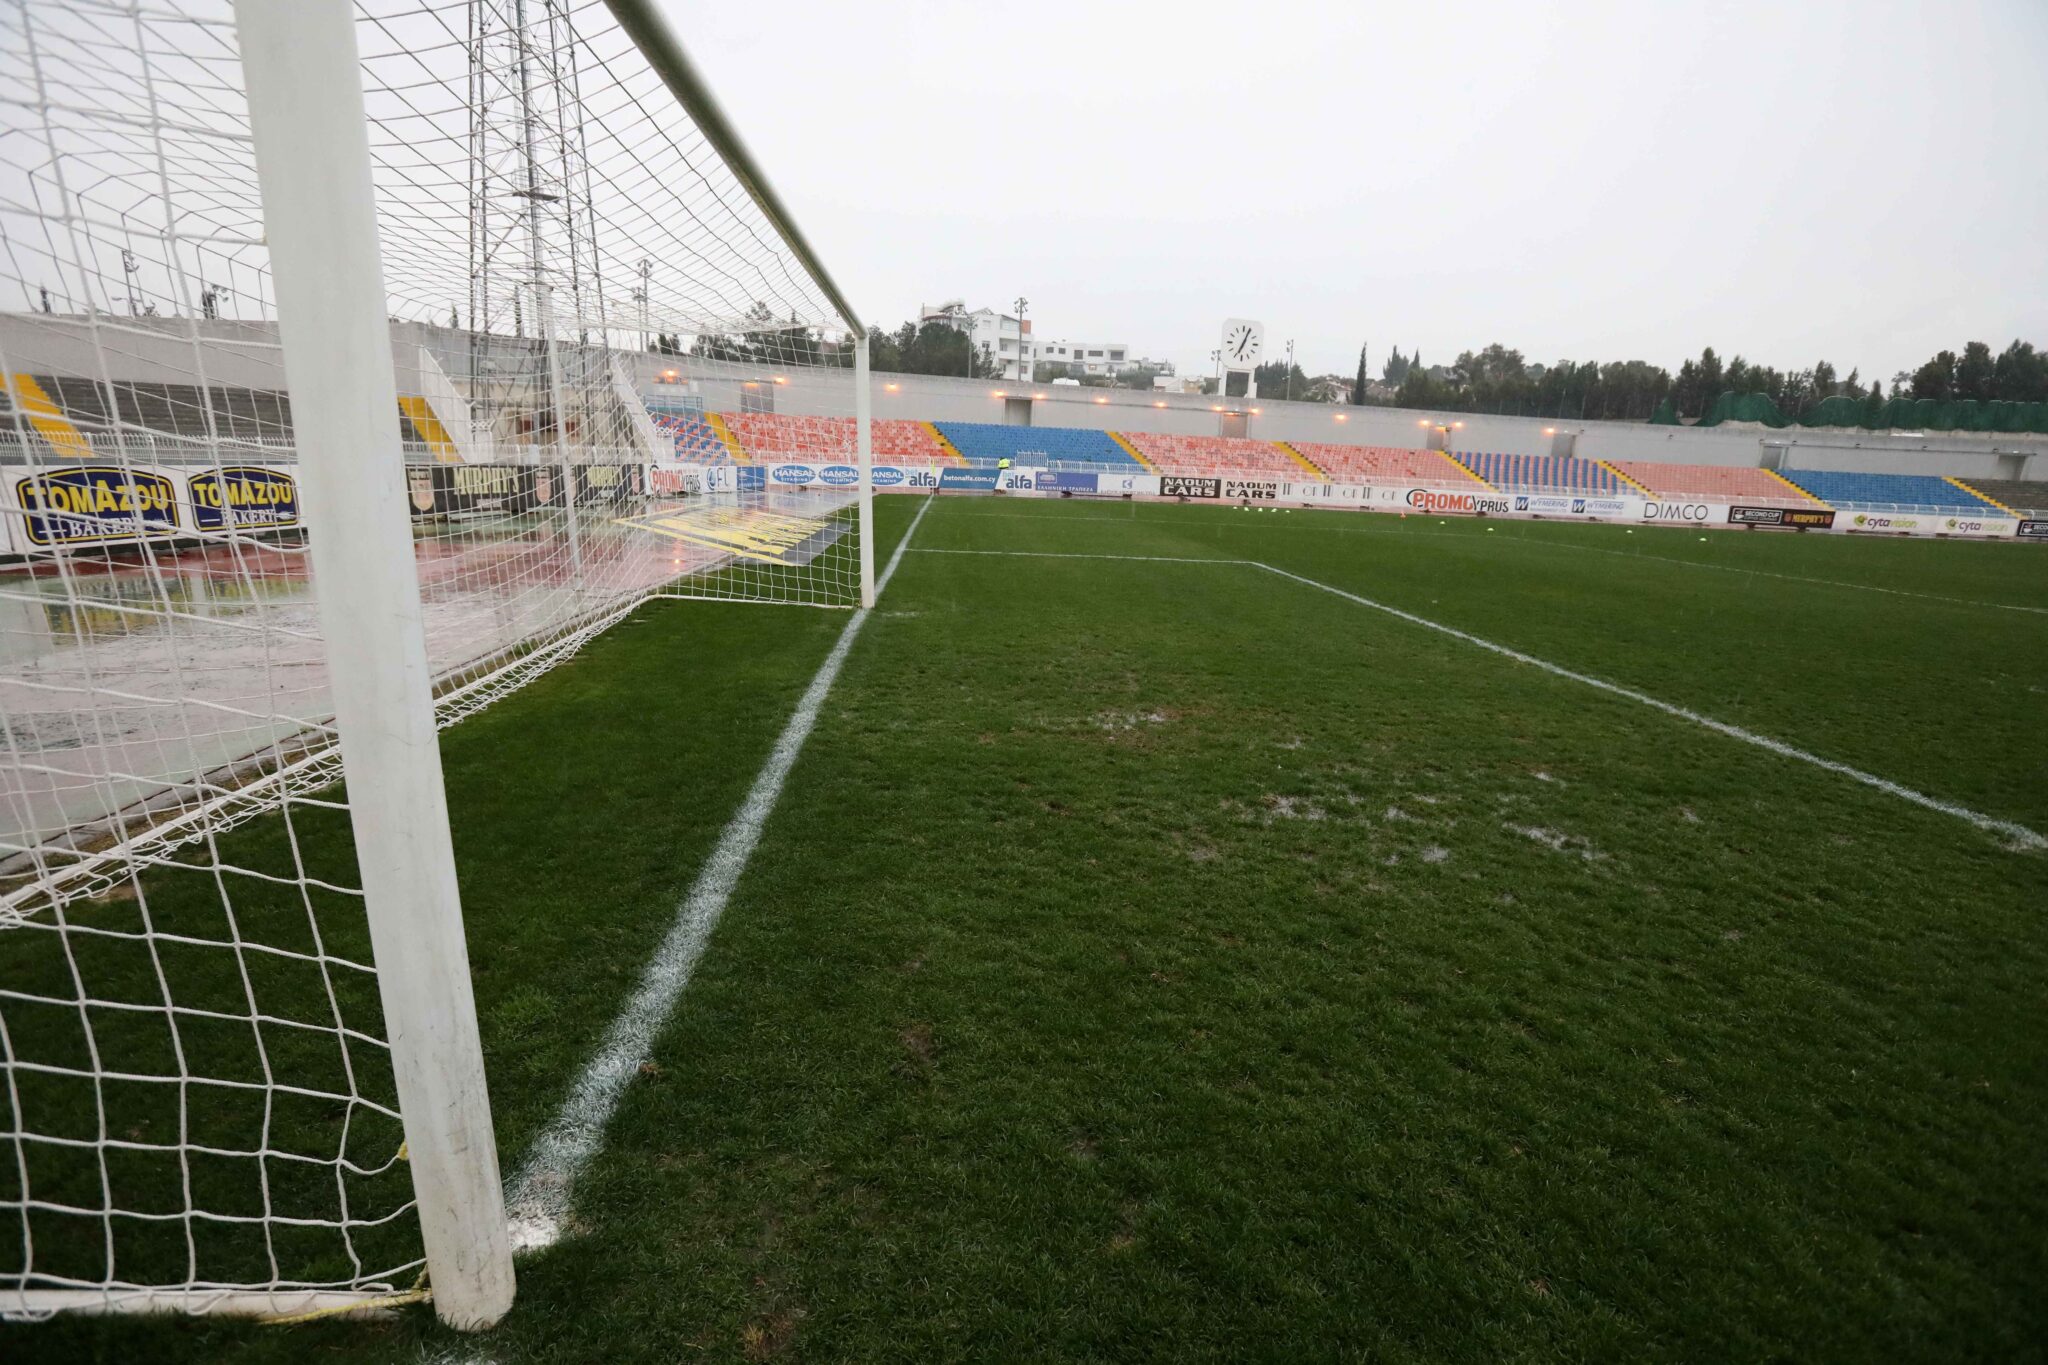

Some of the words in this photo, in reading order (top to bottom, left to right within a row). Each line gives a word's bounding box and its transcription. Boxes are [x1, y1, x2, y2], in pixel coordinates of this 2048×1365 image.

[774, 469, 816, 478] HANSAL
[820, 470, 859, 479] HANSAL
[872, 471, 904, 479] ANSAL
[908, 472, 937, 487] alfa
[1005, 474, 1033, 489] alfa
[1164, 478, 1216, 487] NAOUM
[1226, 481, 1277, 490] NAOUM
[26, 480, 169, 514] TOMAZOU
[193, 478, 293, 508] TOMAZOU
[1163, 486, 1215, 497] CARS
[1225, 488, 1276, 499] CARS
[1644, 502, 1709, 521] DIMCO
[68, 516, 144, 538] BAKER
